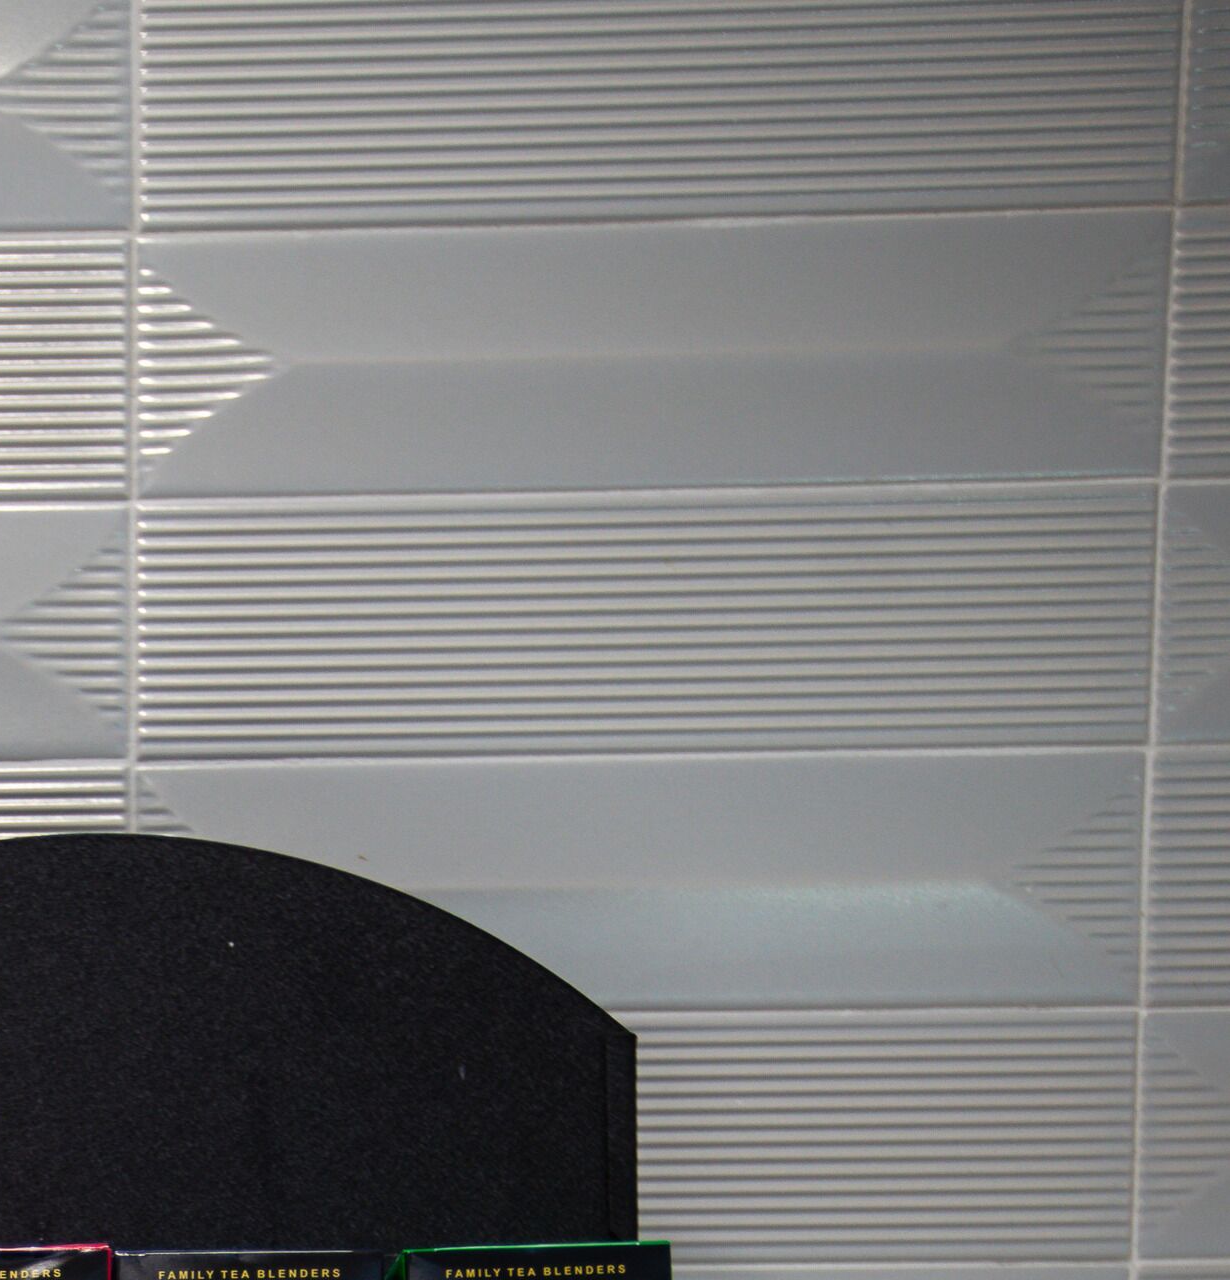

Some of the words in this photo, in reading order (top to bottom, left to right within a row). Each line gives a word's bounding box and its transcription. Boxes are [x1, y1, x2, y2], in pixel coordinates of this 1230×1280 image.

[158, 1269, 214, 1280] FAMILY
[220, 1269, 253, 1279] TEA
[257, 1268, 341, 1279] BLENDERS
[445, 1267, 502, 1278] FAMILY
[507, 1266, 538, 1277] TEA
[542, 1264, 626, 1276] BLENDERS
